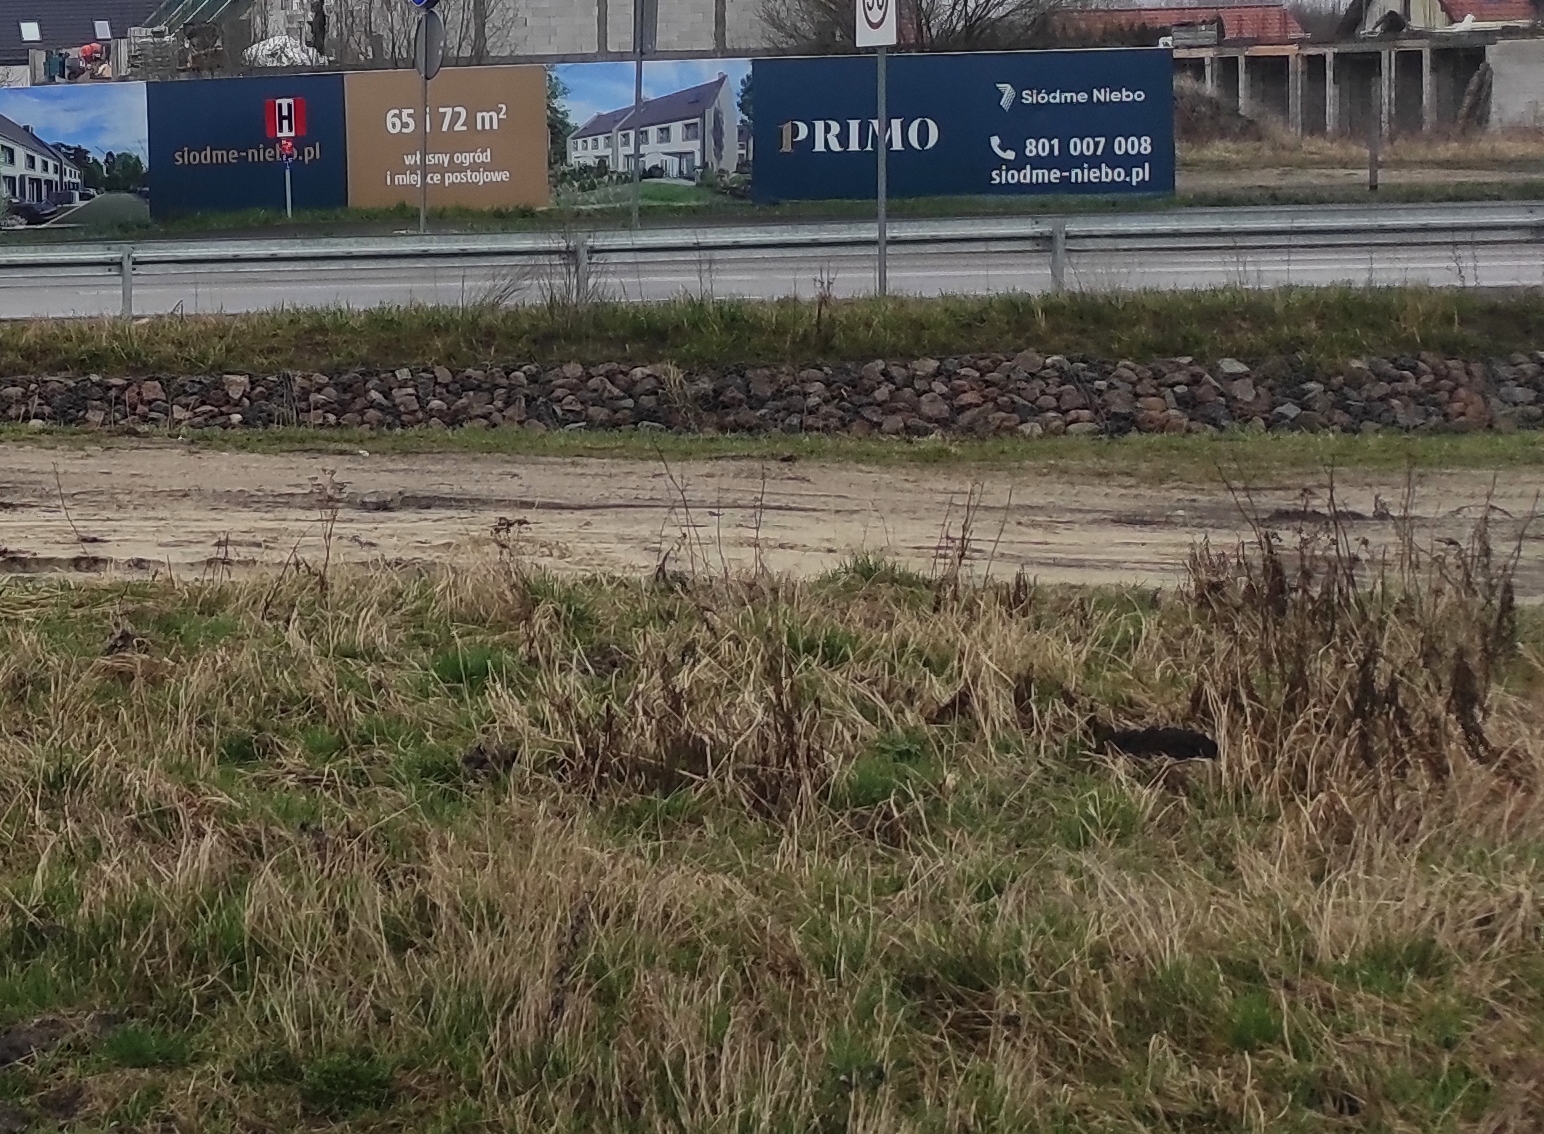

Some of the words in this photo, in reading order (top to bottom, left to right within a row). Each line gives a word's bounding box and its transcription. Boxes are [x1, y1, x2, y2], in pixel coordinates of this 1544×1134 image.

[1021, 87, 1088, 104] Siódme
[1092, 86, 1145, 103] Niebo
[277, 102, 293, 133] H
[386, 109, 415, 134] 65
[439, 107, 468, 132] 72
[778, 117, 940, 154] PRIMO
[1024, 138, 1059, 157] 801
[1068, 137, 1106, 156] 007
[1114, 136, 1152, 155] 008
[454, 148, 491, 166] ogród
[395, 170, 441, 187] miejce
[445, 167, 510, 186] postojowe
[990, 163, 1150, 186] siodme-niebo.pl
